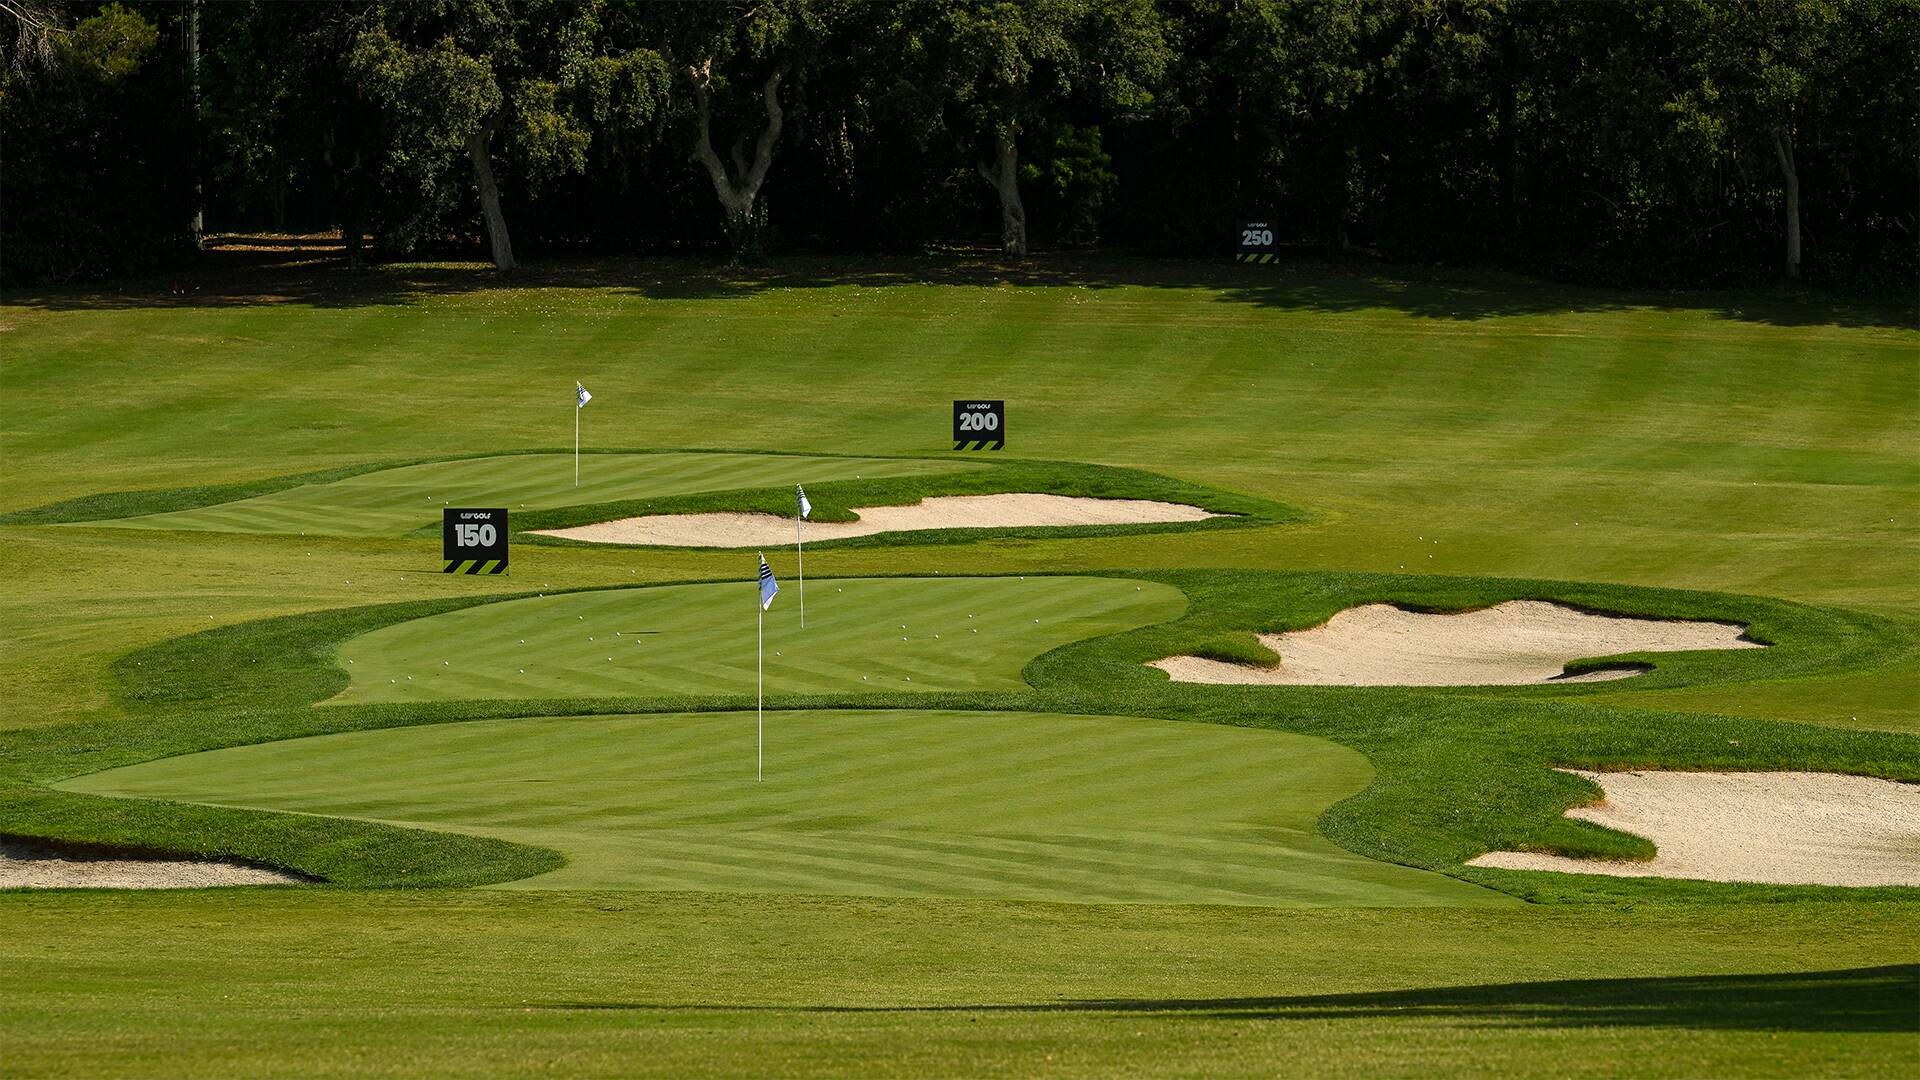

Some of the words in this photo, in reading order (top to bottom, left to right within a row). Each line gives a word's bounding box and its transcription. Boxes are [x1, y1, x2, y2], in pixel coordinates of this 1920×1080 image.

[1242, 230, 1273, 245] 250
[960, 413, 998, 431] 200
[455, 524, 497, 547] 150
